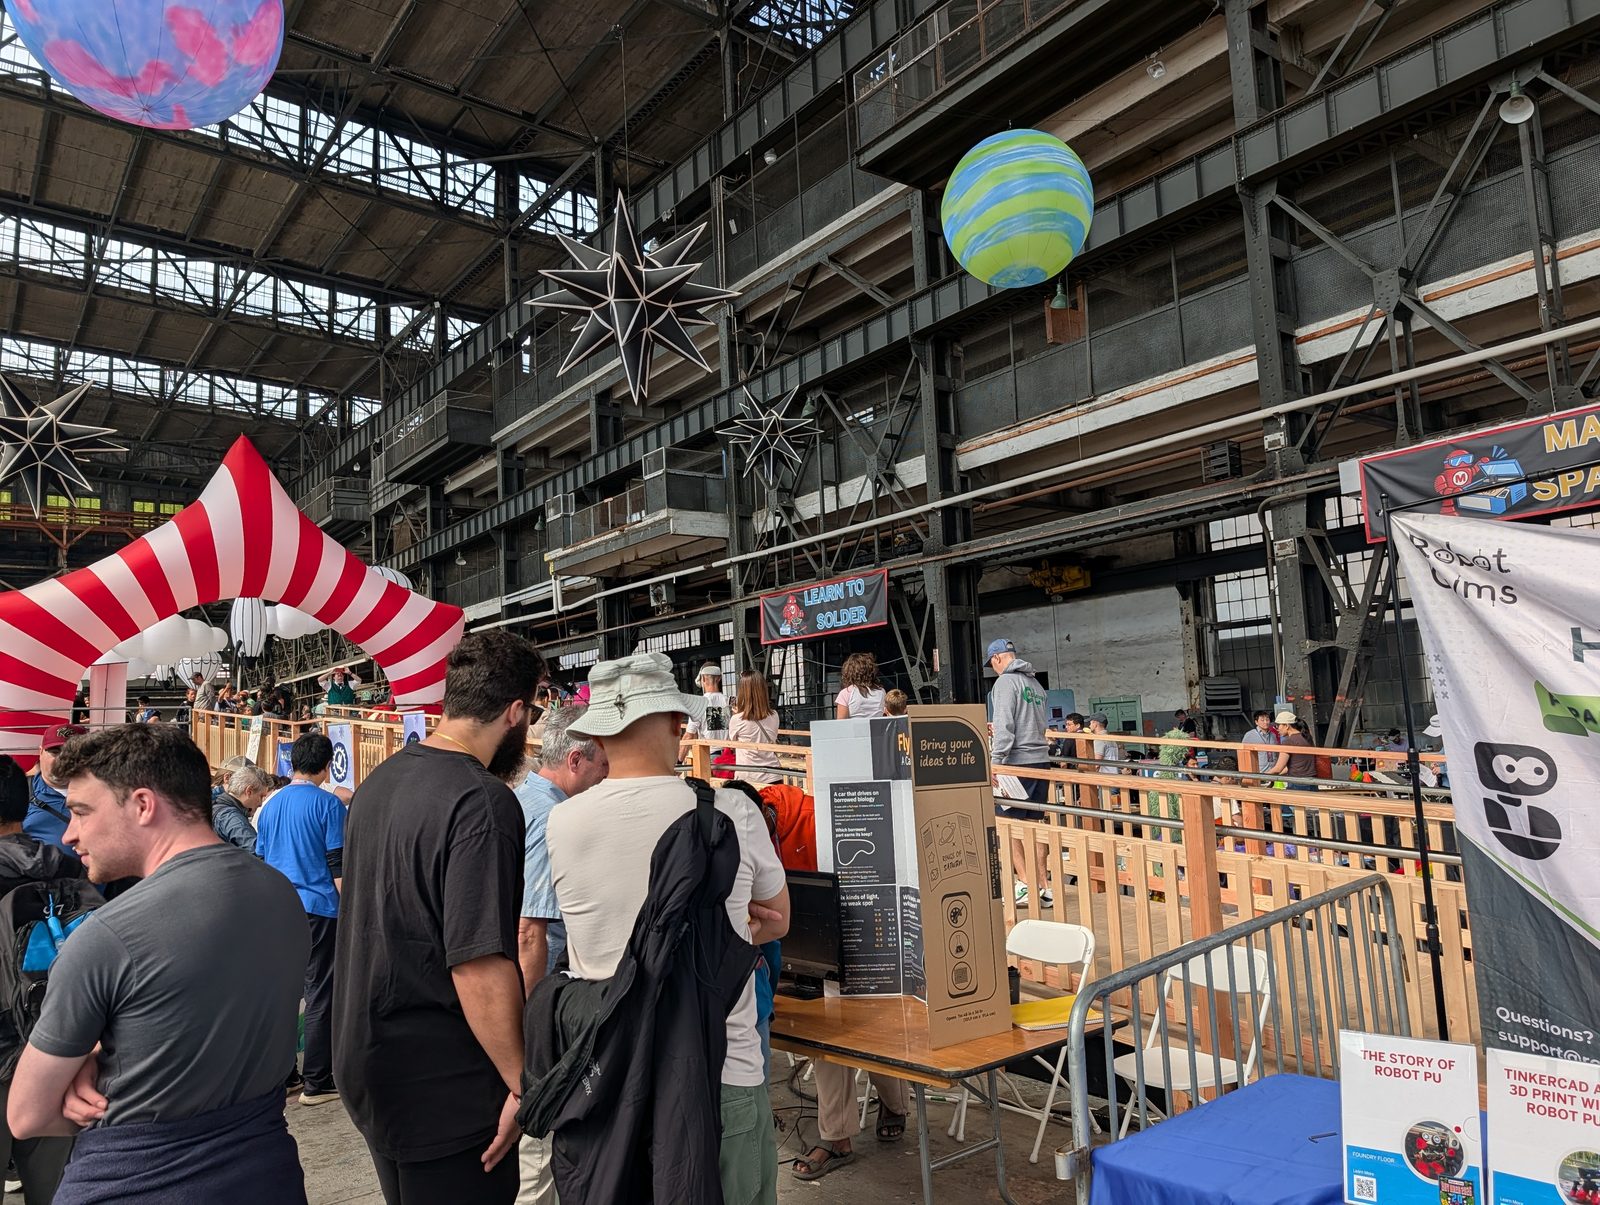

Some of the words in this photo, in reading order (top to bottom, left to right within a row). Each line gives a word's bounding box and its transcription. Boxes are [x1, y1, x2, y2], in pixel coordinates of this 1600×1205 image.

[1543, 414, 1600, 453] MA
[804, 582, 844, 606] LEARN
[846, 578, 865, 597] TO
[816, 605, 868, 630] SOLDER
[920, 739, 946, 753] Bring
[950, 740, 973, 752] your
[920, 755, 943, 767] ideas
[947, 755, 957, 766] to
[961, 752, 976, 765] life
[942, 853, 955, 861] RINGS
[943, 859, 963, 871] SATURN
[866, 893, 880, 901] light,
[1496, 1006, 1594, 1045] Questions?
[1360, 1049, 1386, 1062] THE
[1389, 1053, 1434, 1068] STORY
[1437, 1059, 1456, 1071] OF
[1374, 1065, 1420, 1081] ROBOT
[1423, 1071, 1442, 1083] PU
[1504, 1068, 1589, 1093] TINKERCAD
[1509, 1084, 1528, 1097] 3D
[1532, 1088, 1577, 1106] PRINT
[1526, 1102, 1578, 1122] ROBOT
[1582, 1113, 1600, 1127] PU
[1352, 1151, 1377, 1161] FOUNDRY
[1377, 1155, 1395, 1163] FLOOR
